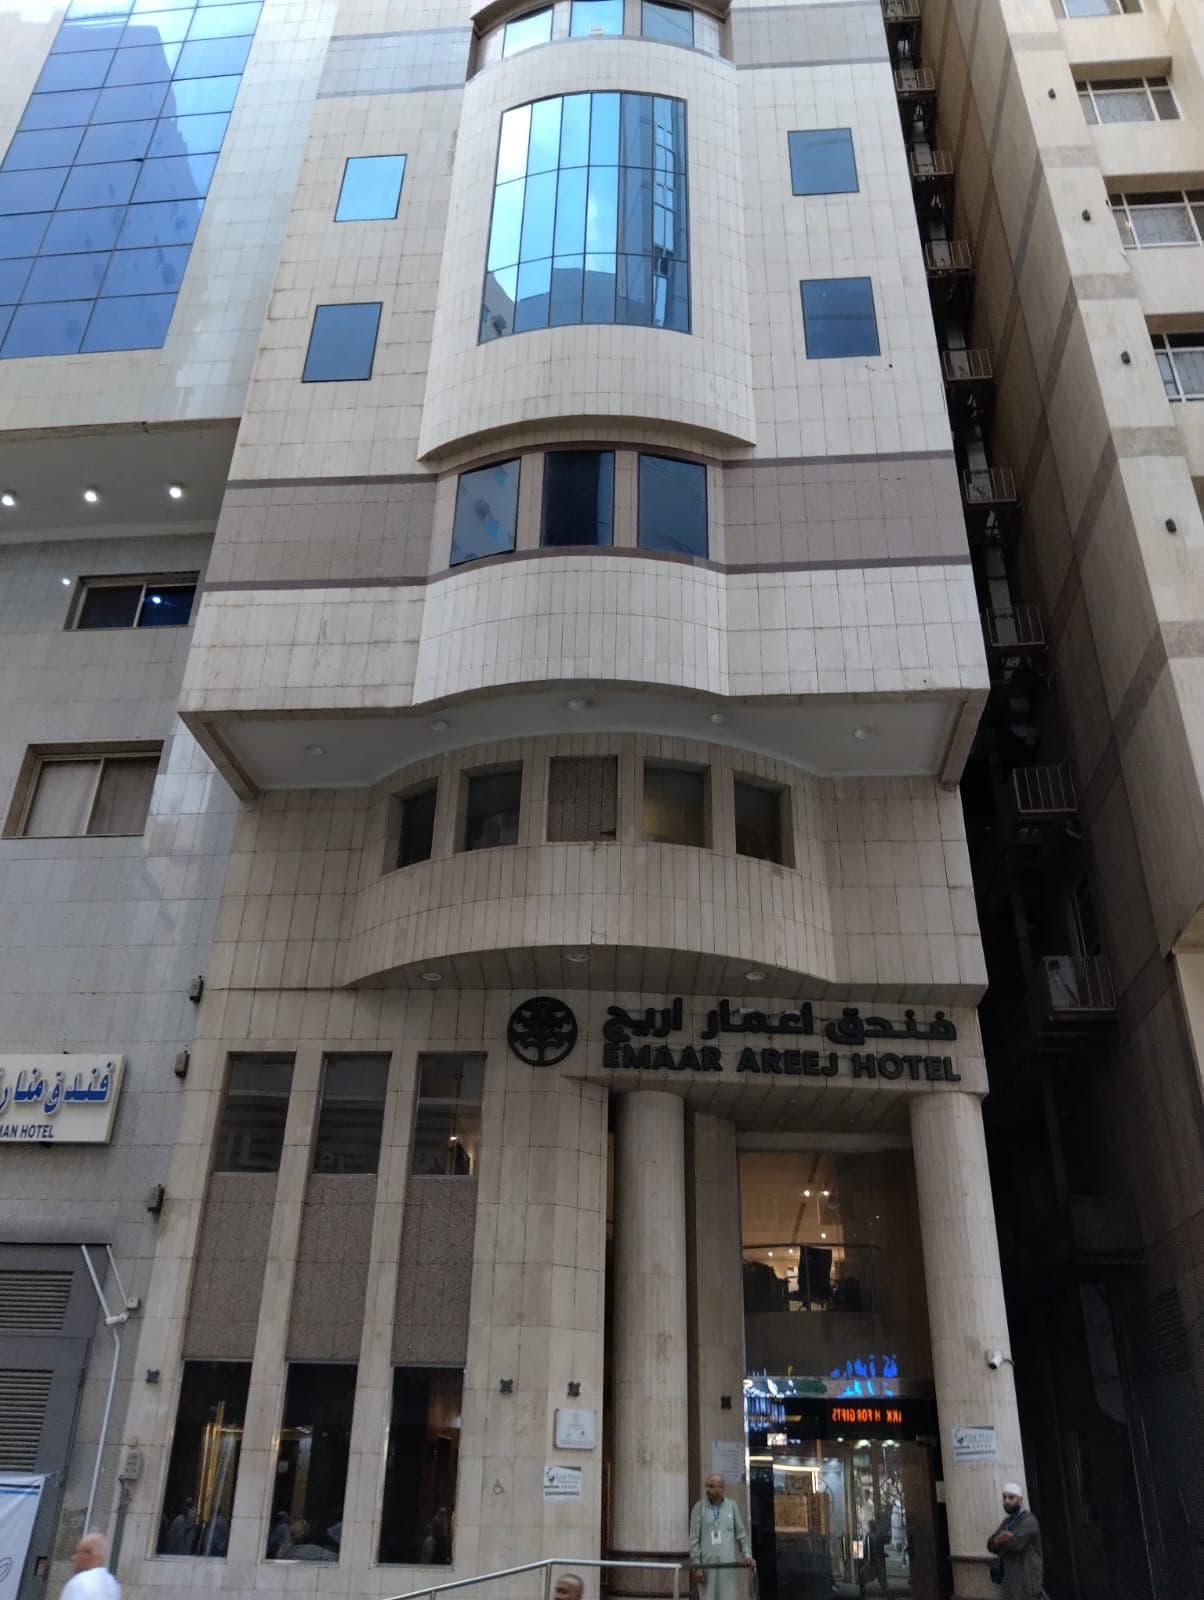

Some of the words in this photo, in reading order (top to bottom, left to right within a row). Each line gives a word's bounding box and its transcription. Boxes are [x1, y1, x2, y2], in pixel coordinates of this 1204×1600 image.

[602, 996, 683, 1042] اريج
[701, 998, 814, 1040] اعمار
[826, 1007, 957, 1046] فندق
[603, 1043, 723, 1072] EMAAR
[736, 1047, 839, 1077] AREEJ
[853, 1052, 962, 1082] HOTEL
[43, 1061, 113, 1113] فندق
[20, 1124, 54, 1138] HOTEL
